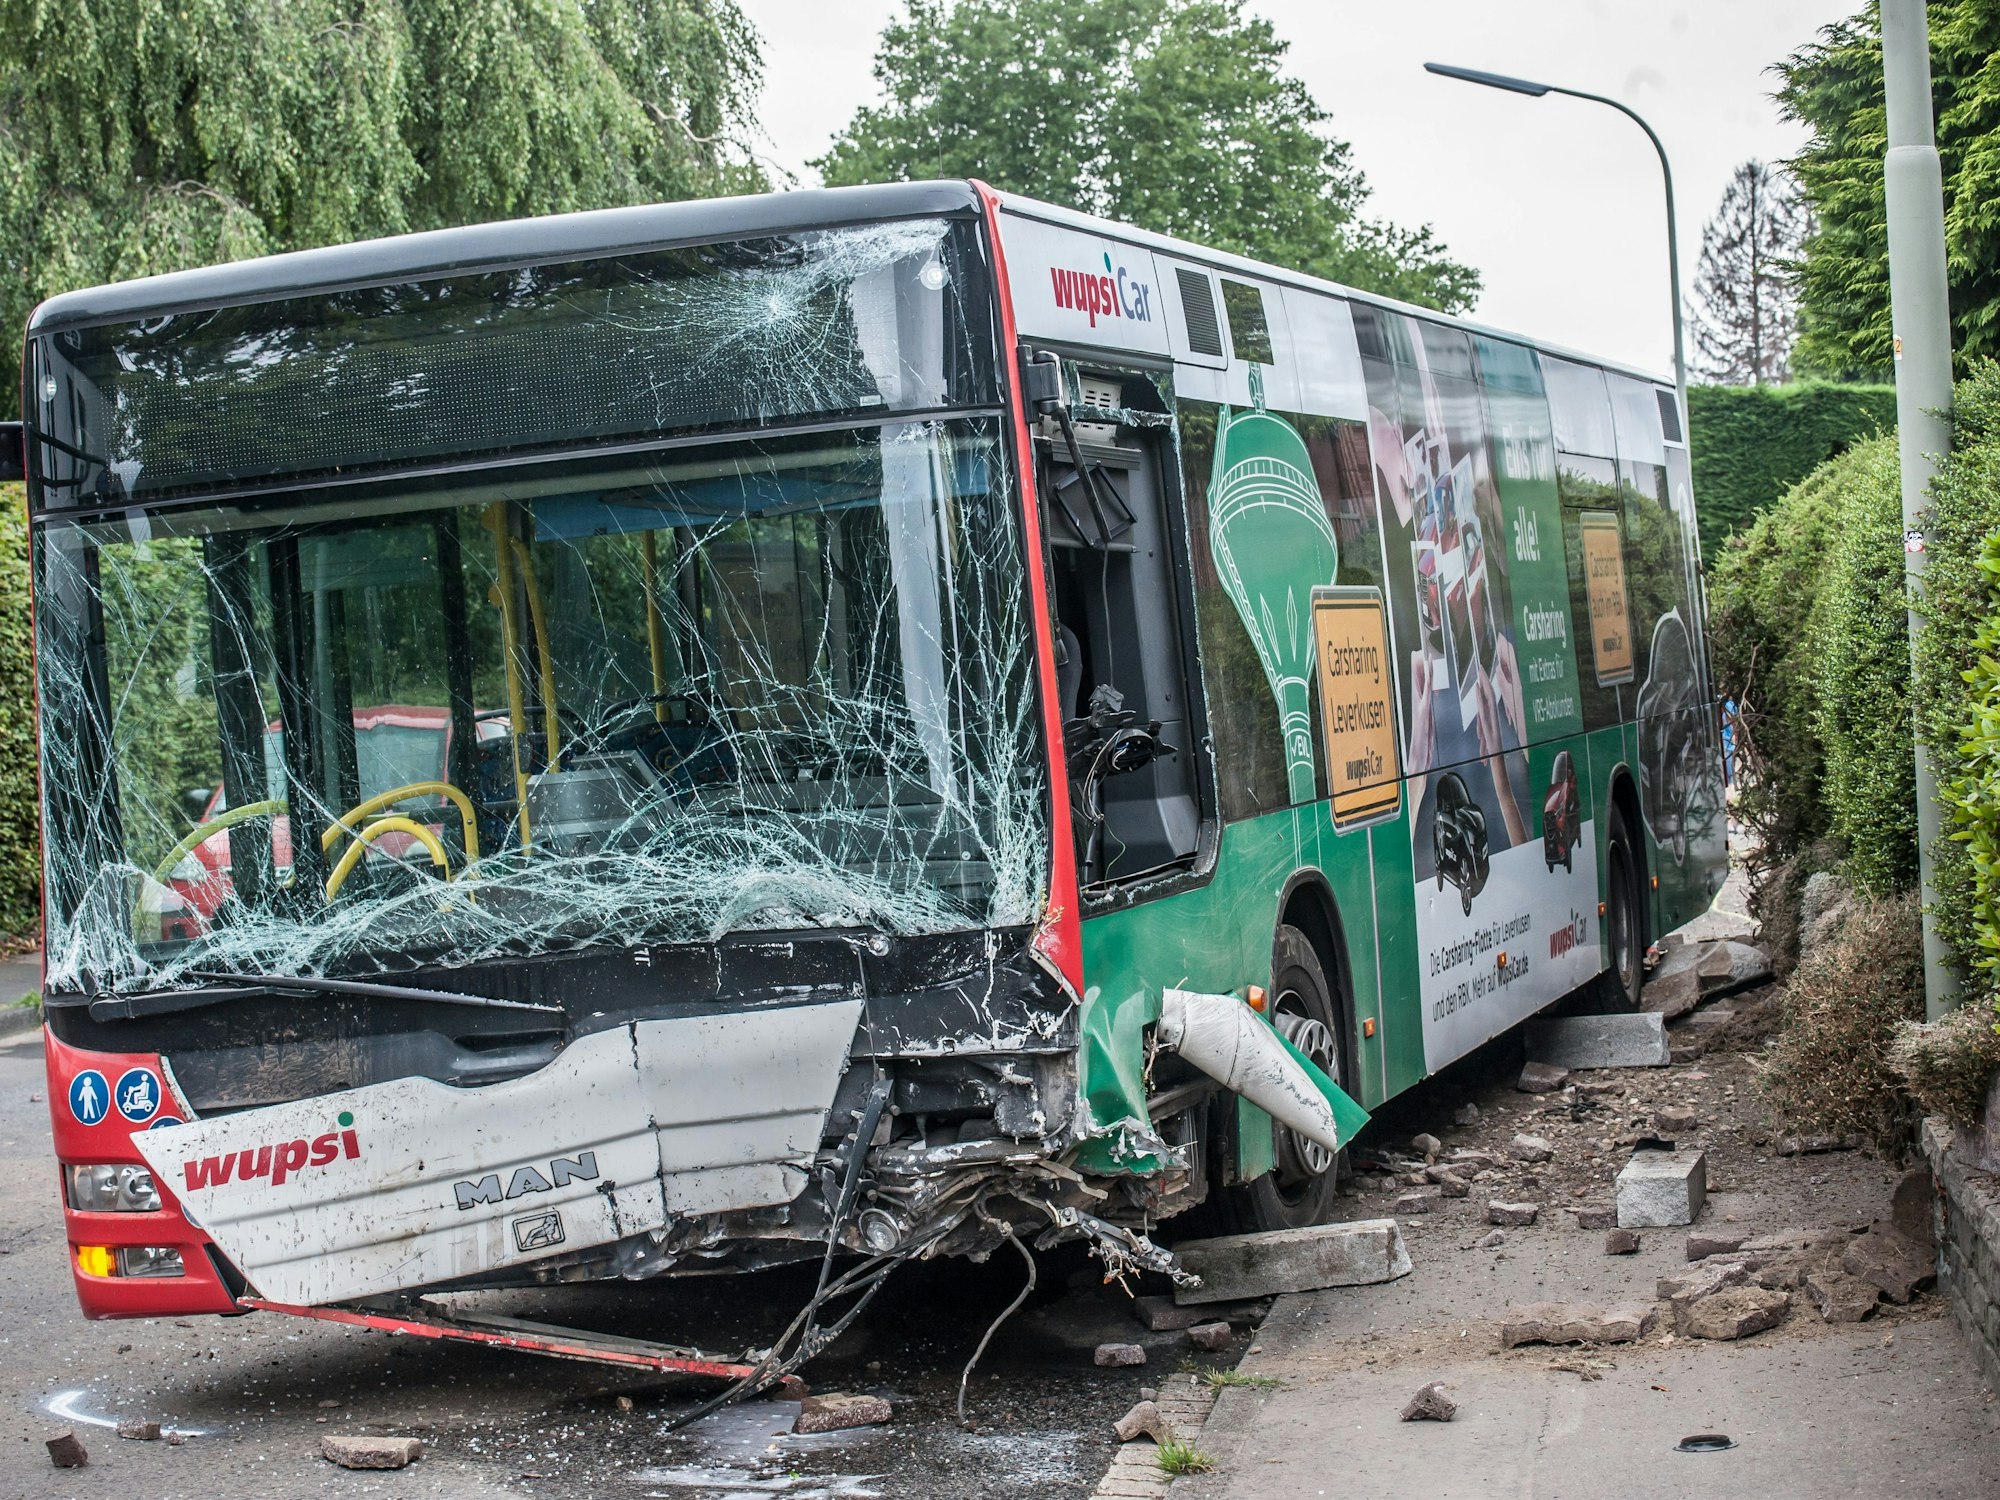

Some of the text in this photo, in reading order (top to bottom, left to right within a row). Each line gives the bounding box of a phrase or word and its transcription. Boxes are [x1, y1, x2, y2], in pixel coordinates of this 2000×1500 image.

[1050, 251, 1151, 328] wupsiCar
[1513, 506, 1541, 561] alle!
[1523, 600, 1567, 648] Carsharing
[1327, 636, 1379, 684] Carsharing
[1528, 657, 1539, 683] mit
[1538, 657, 1556, 681] Extras
[1330, 694, 1386, 734] Leverkusen
[1345, 746, 1383, 786] wupsiCar
[1430, 913, 1531, 977] Die Carsharing-Flotte für Leverkusen
[1550, 908, 1587, 960] wupsiCar
[1432, 992, 1444, 1022] und
[1445, 989, 1458, 1015] den
[1472, 971, 1486, 1001] Mehr
[1487, 964, 1496, 993] auf
[183, 1111, 361, 1192] wupsi
[453, 1151, 600, 1211] MAN
